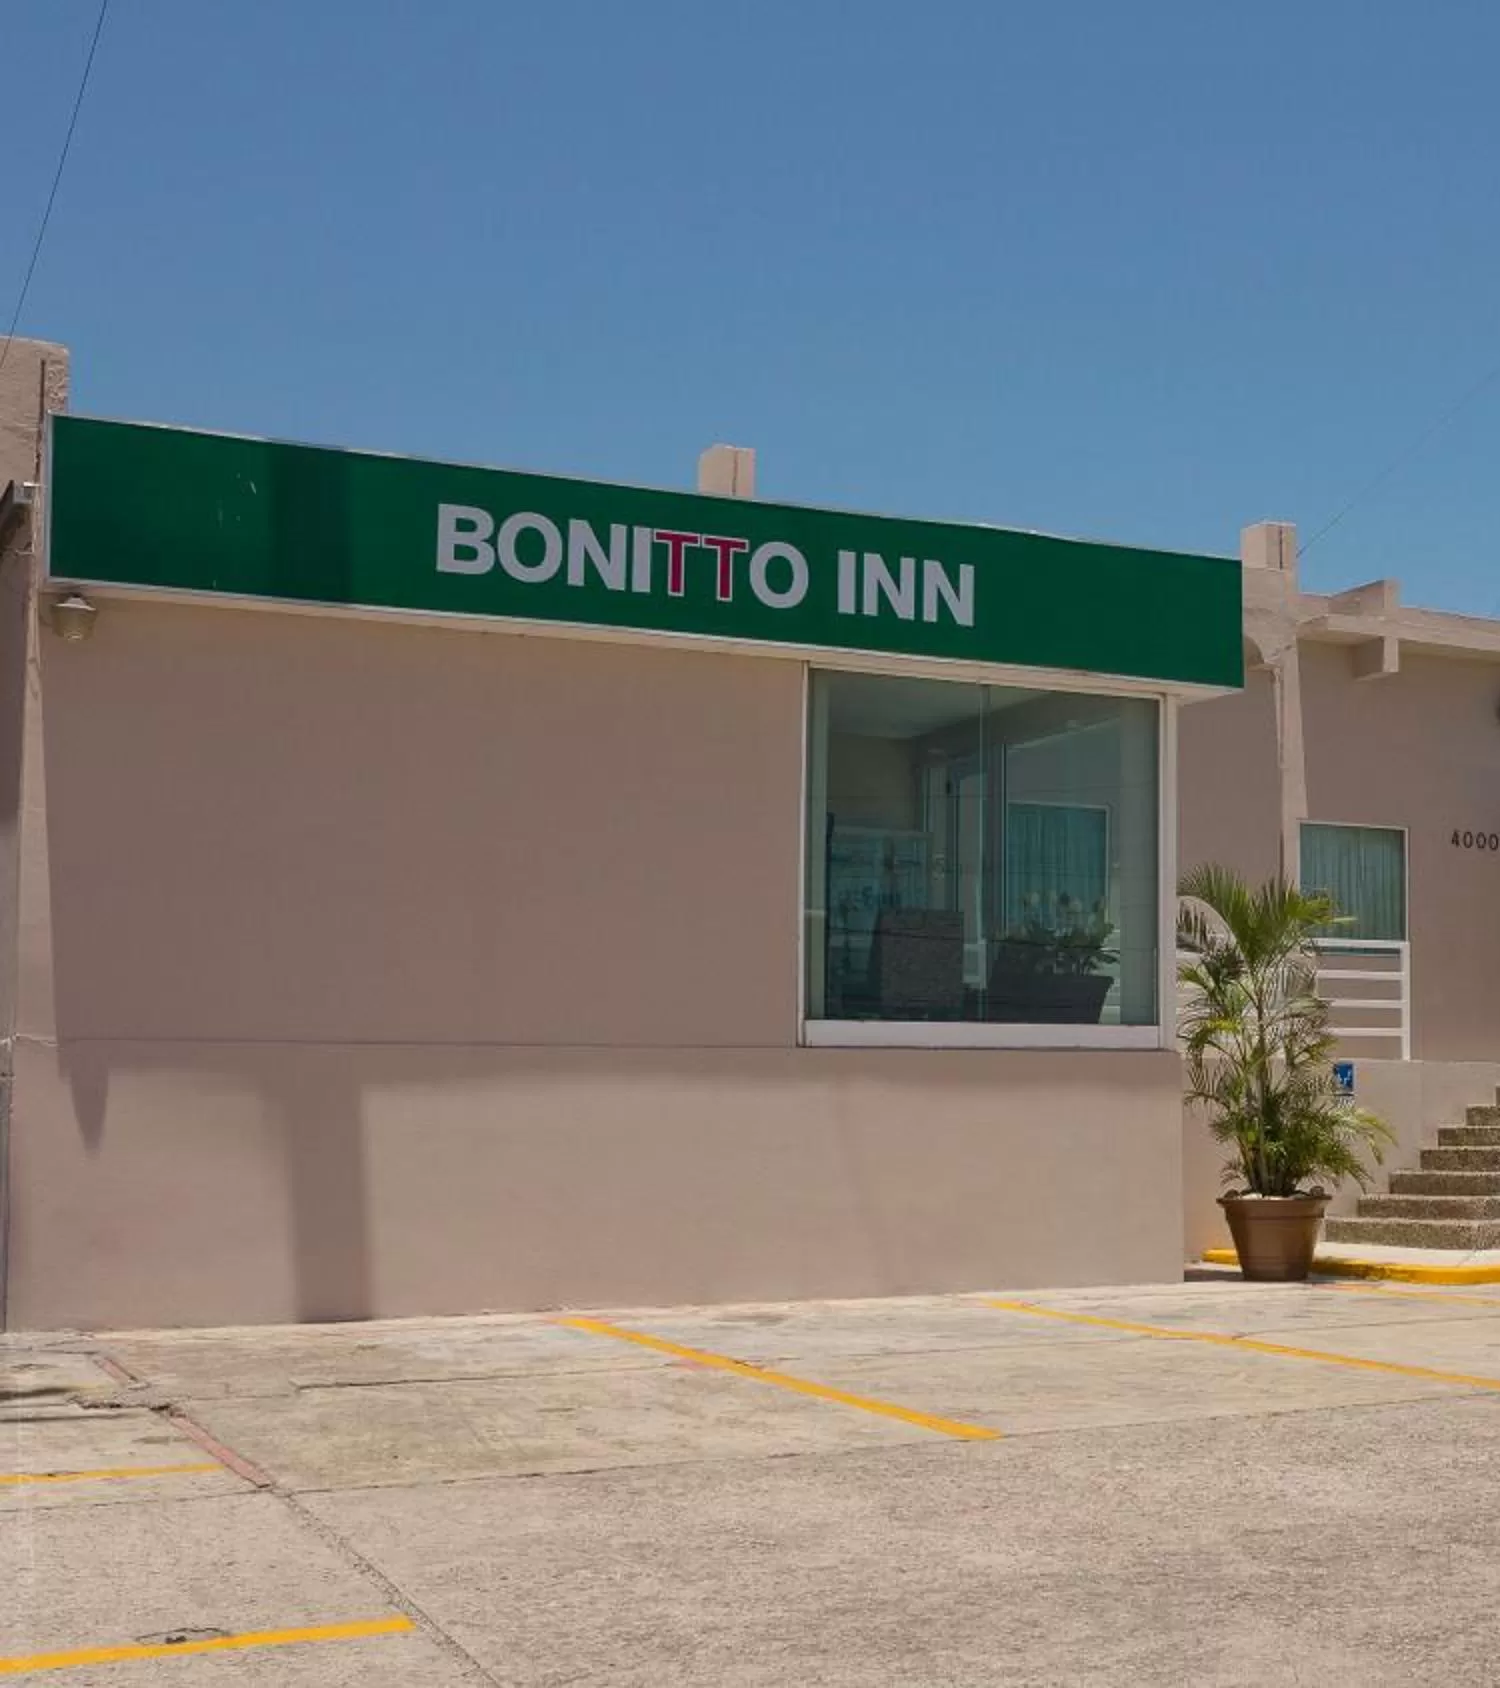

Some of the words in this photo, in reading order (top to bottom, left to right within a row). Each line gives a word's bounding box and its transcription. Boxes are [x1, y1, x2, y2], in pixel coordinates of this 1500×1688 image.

[436, 503, 810, 609] BONITTO
[837, 550, 975, 627] INN
[1451, 830, 1499, 851] 4000
